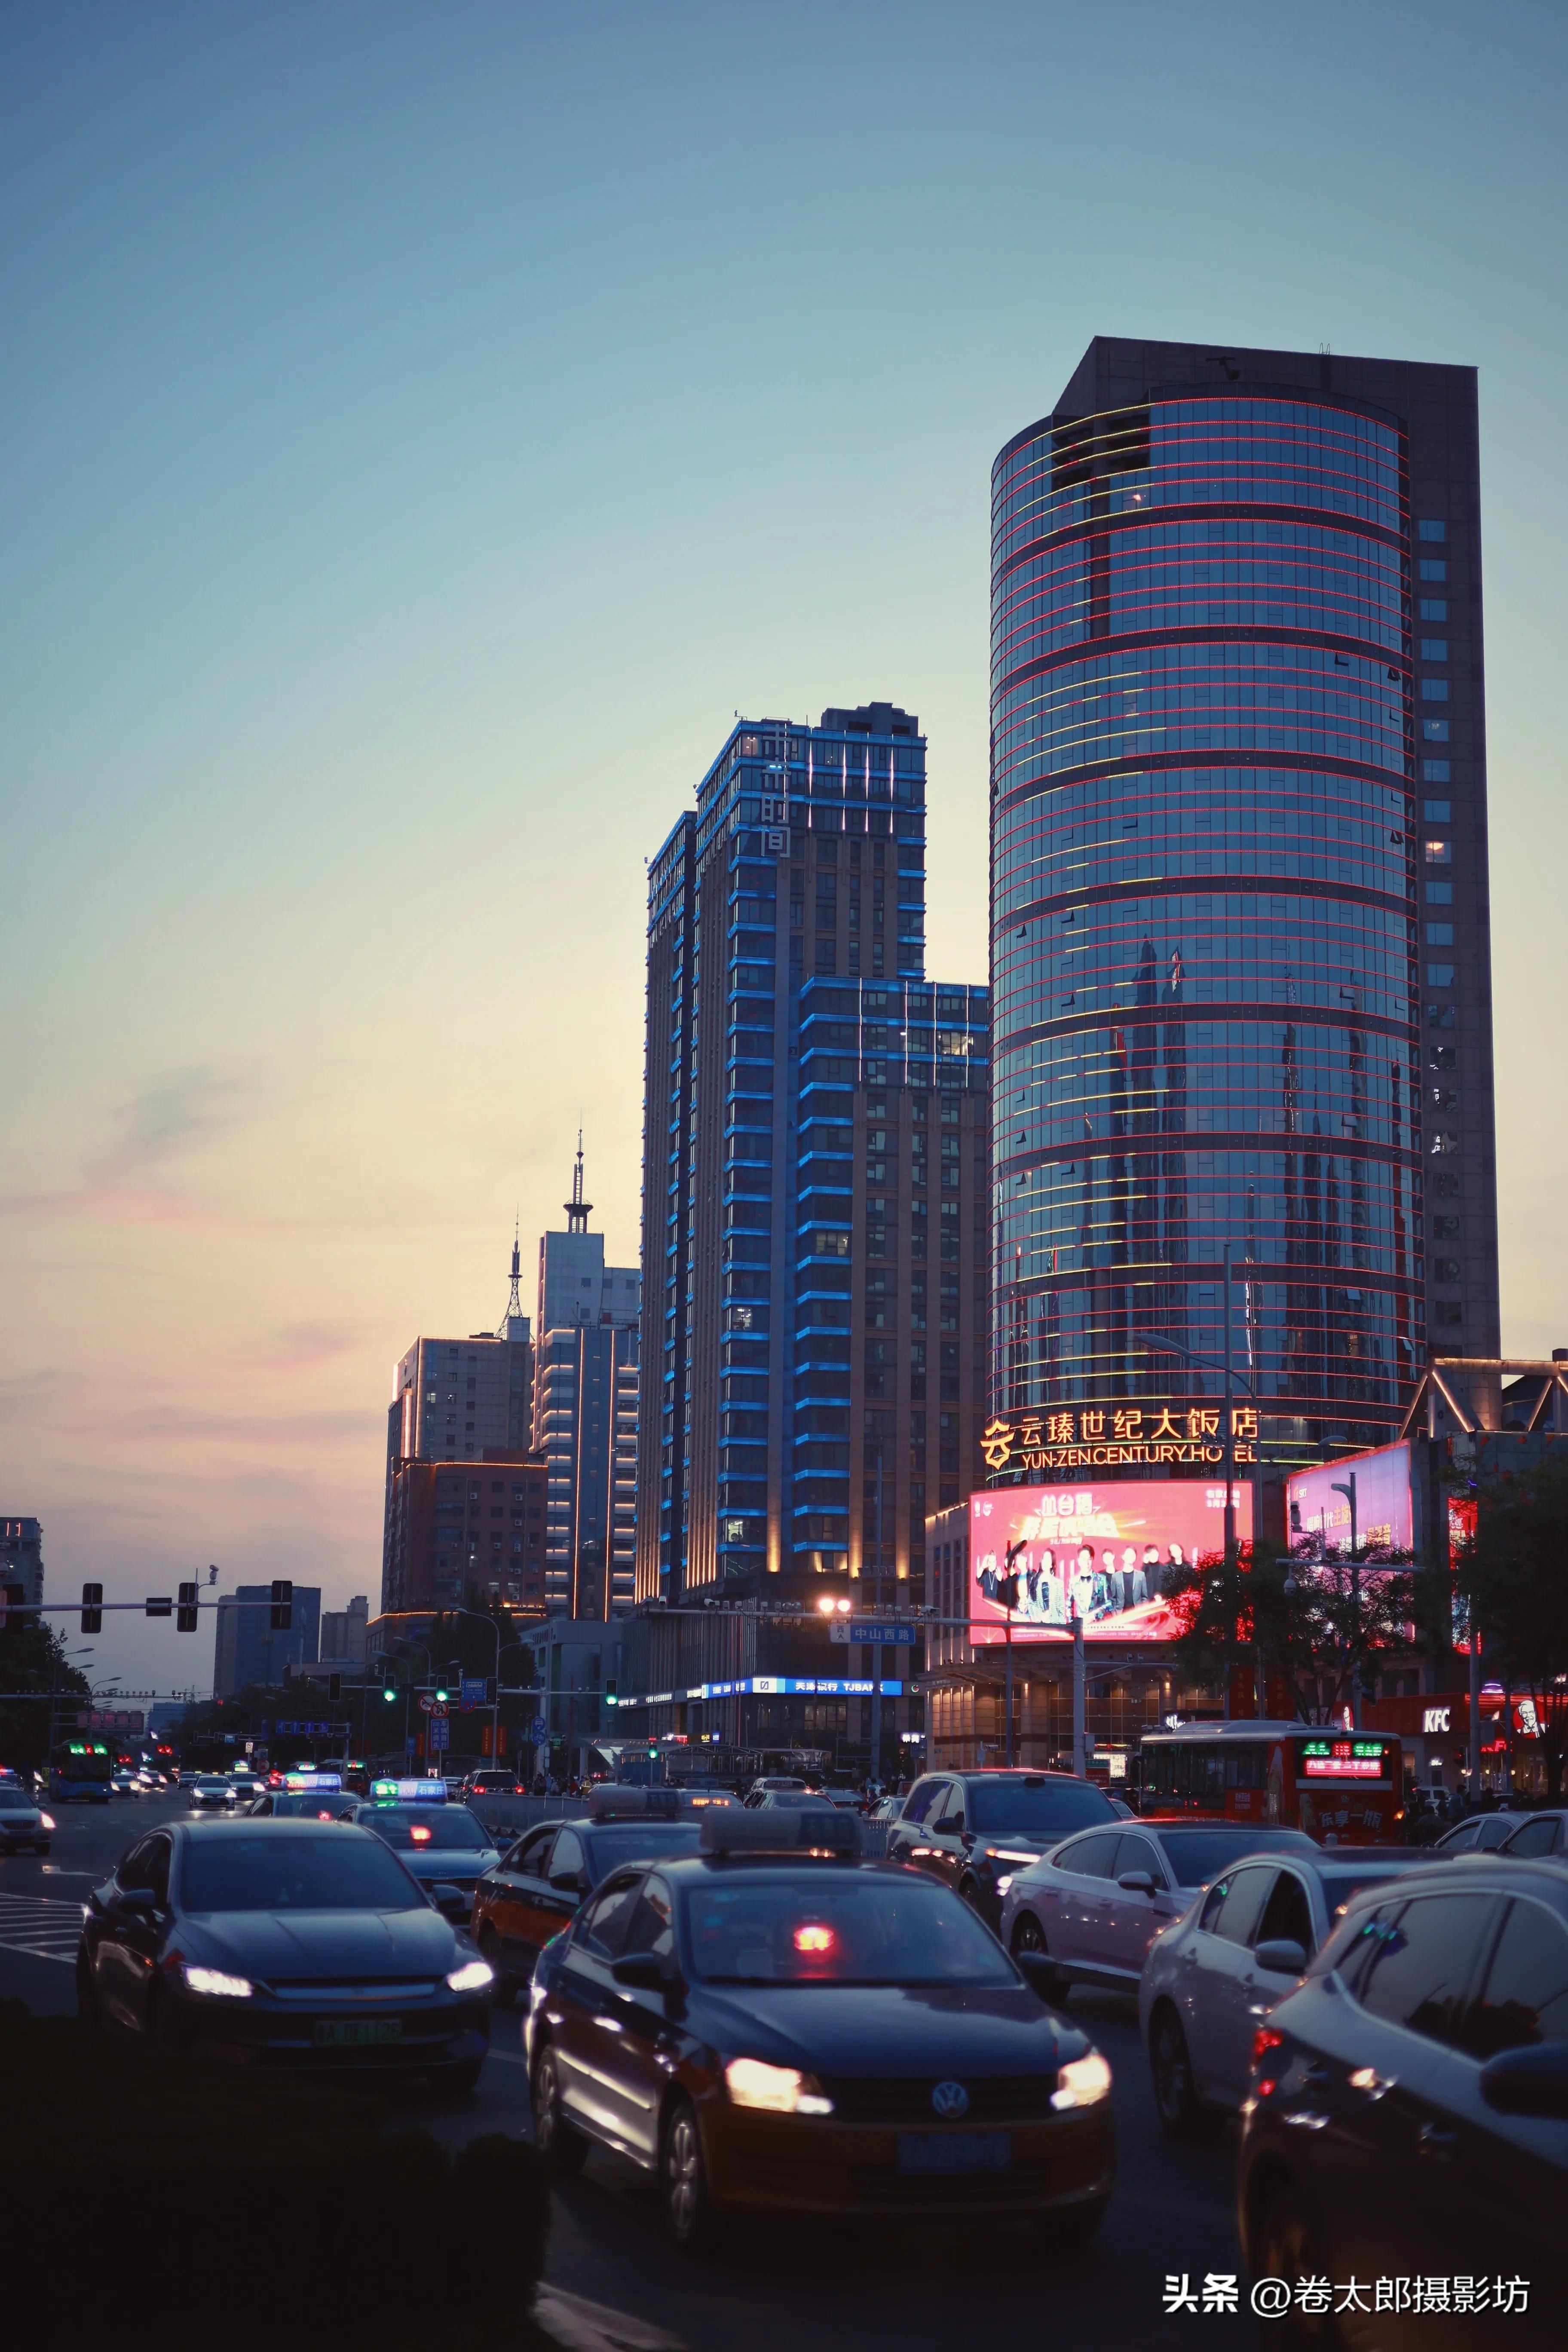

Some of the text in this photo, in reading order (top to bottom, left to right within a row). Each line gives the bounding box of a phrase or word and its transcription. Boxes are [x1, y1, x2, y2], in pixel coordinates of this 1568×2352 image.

[1022, 1444, 1258, 1470] YUN-ZEN CENTURY HOEL
[1298, 1488, 1308, 1498] SRT
[1307, 1504, 1351, 1532] 唱响时代主旋
[854, 1628, 910, 1641] 中山西路
[795, 1682, 838, 1692] 天津银行
[1424, 1709, 1451, 1733] KFC
[419, 1785, 444, 1795] 石家庄
